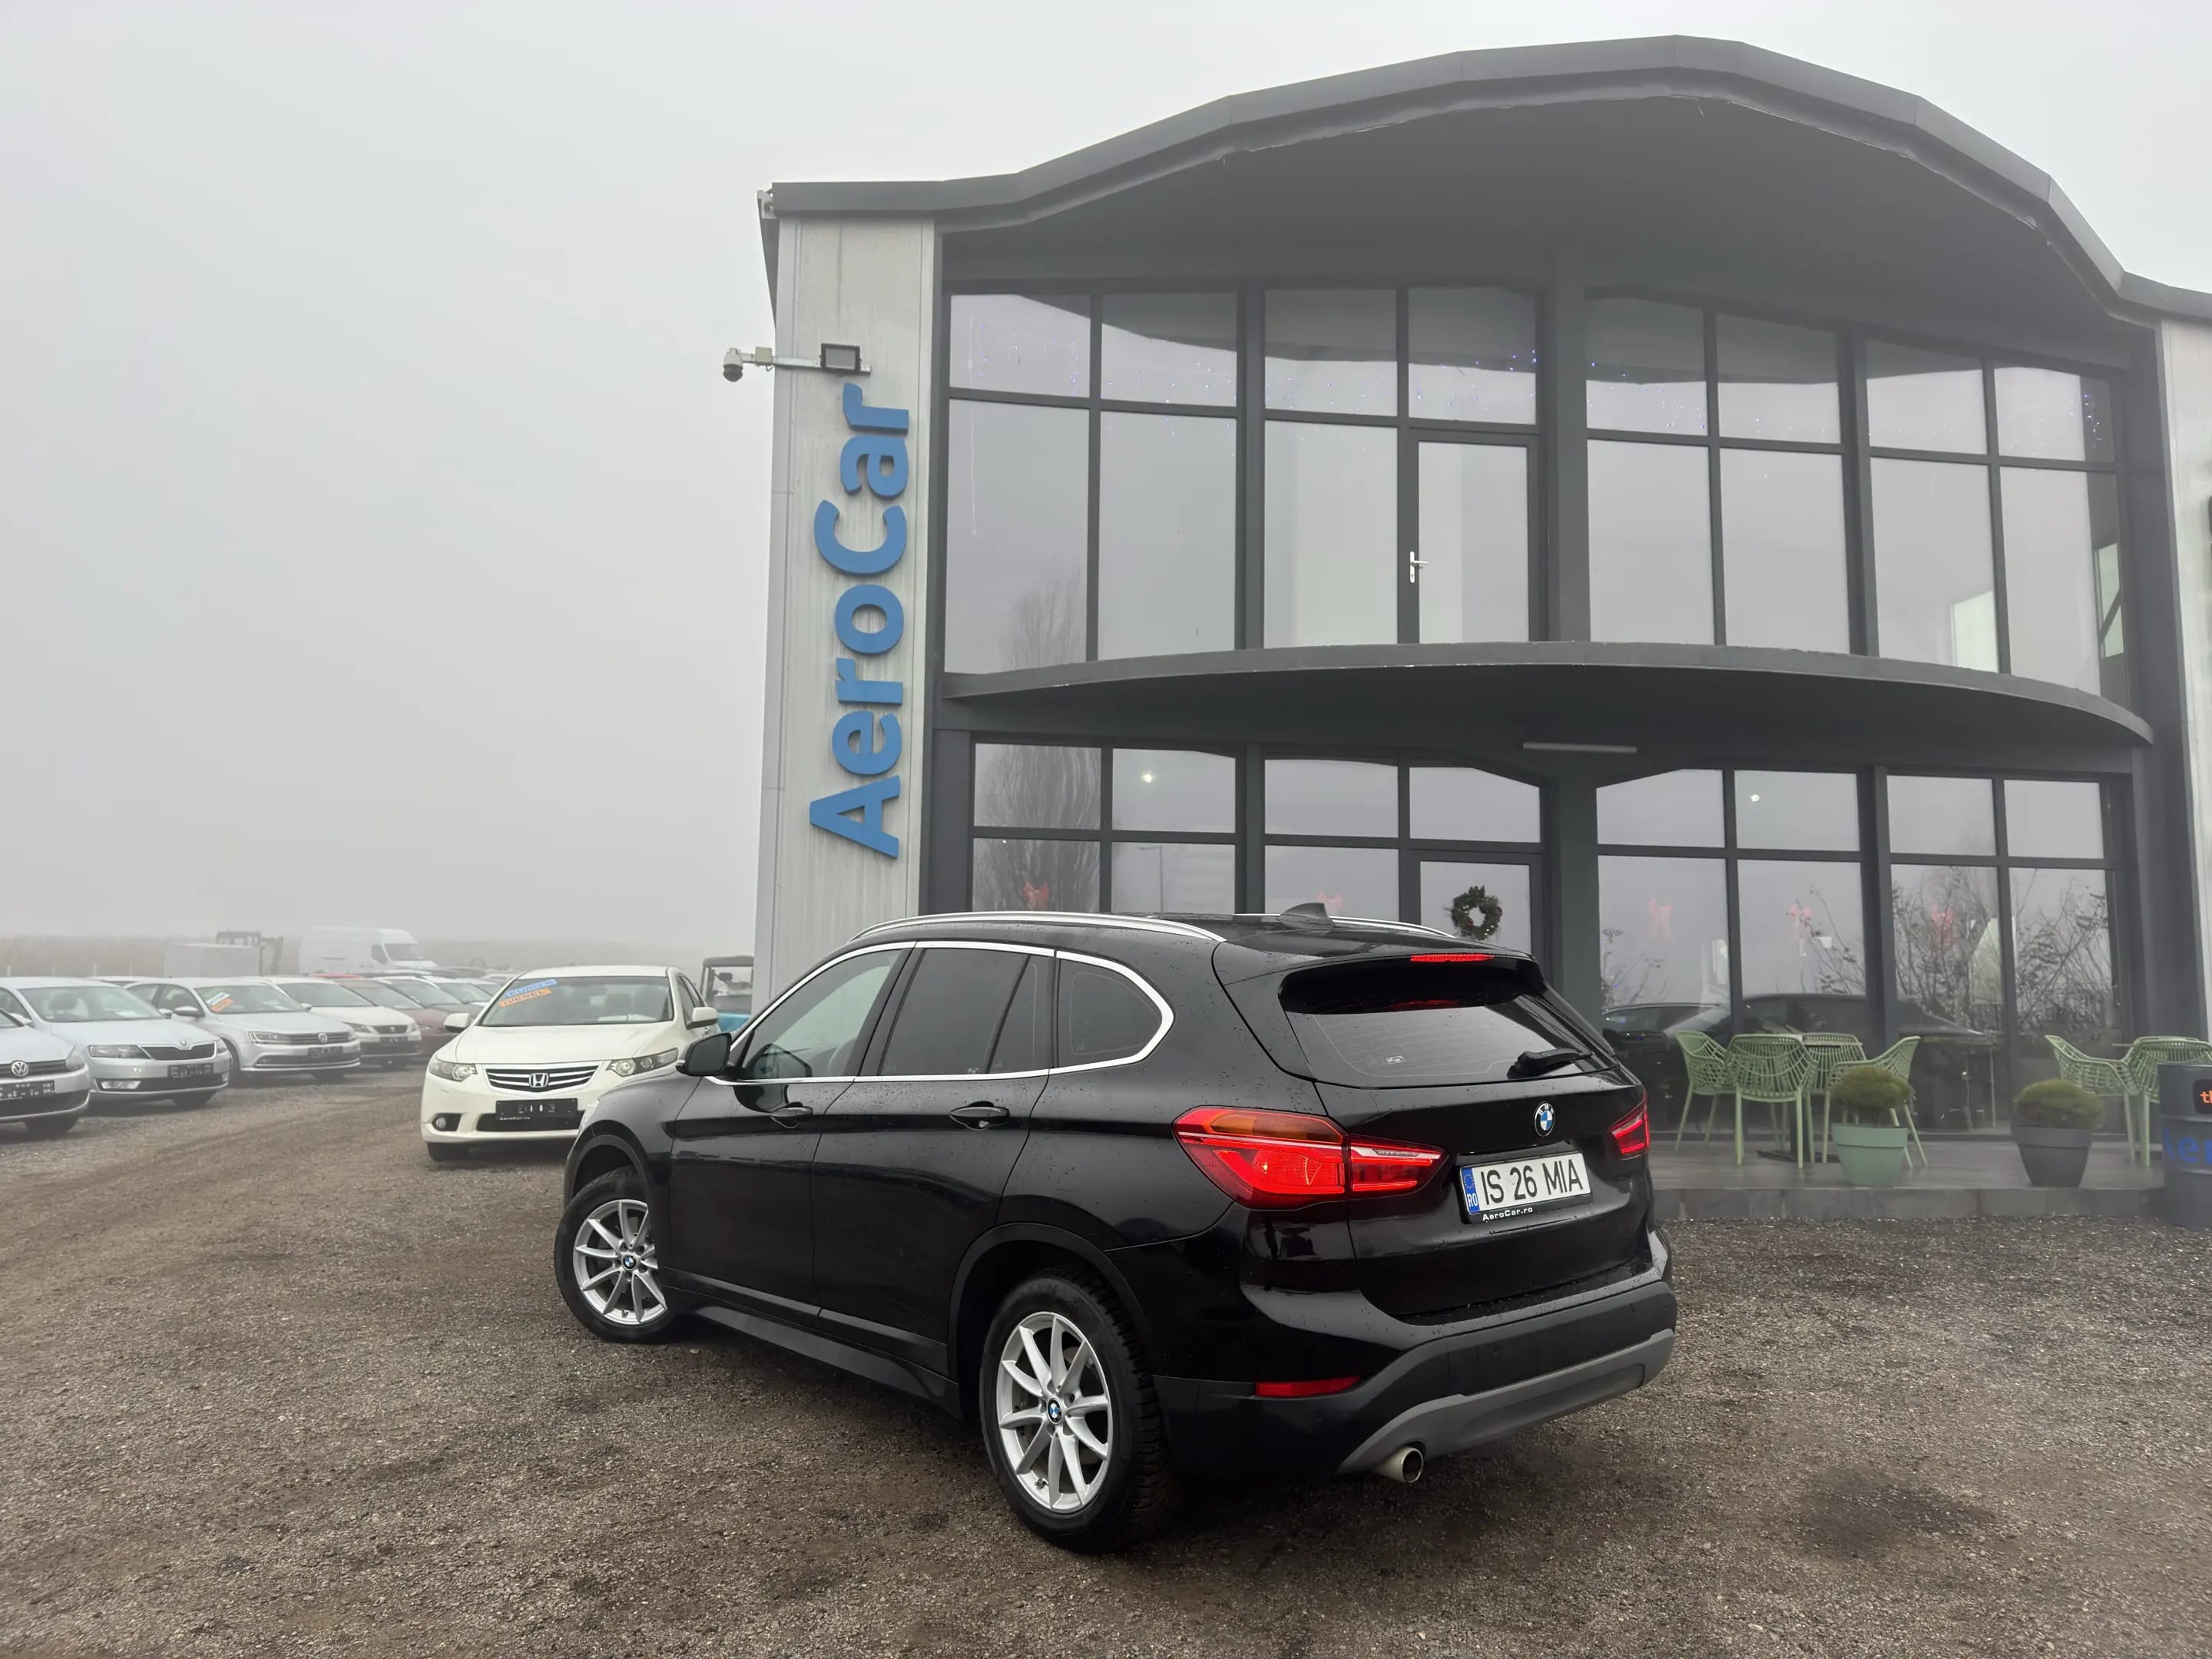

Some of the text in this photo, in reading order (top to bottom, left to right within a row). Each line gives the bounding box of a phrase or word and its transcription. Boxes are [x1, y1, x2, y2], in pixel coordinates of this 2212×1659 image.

[810, 382, 909, 859] AeroCar
[1481, 1159, 1584, 1205] IS 26 MIA
[1467, 1193, 1479, 1207] RO
[1482, 1207, 1533, 1221] AeroCar.ro
